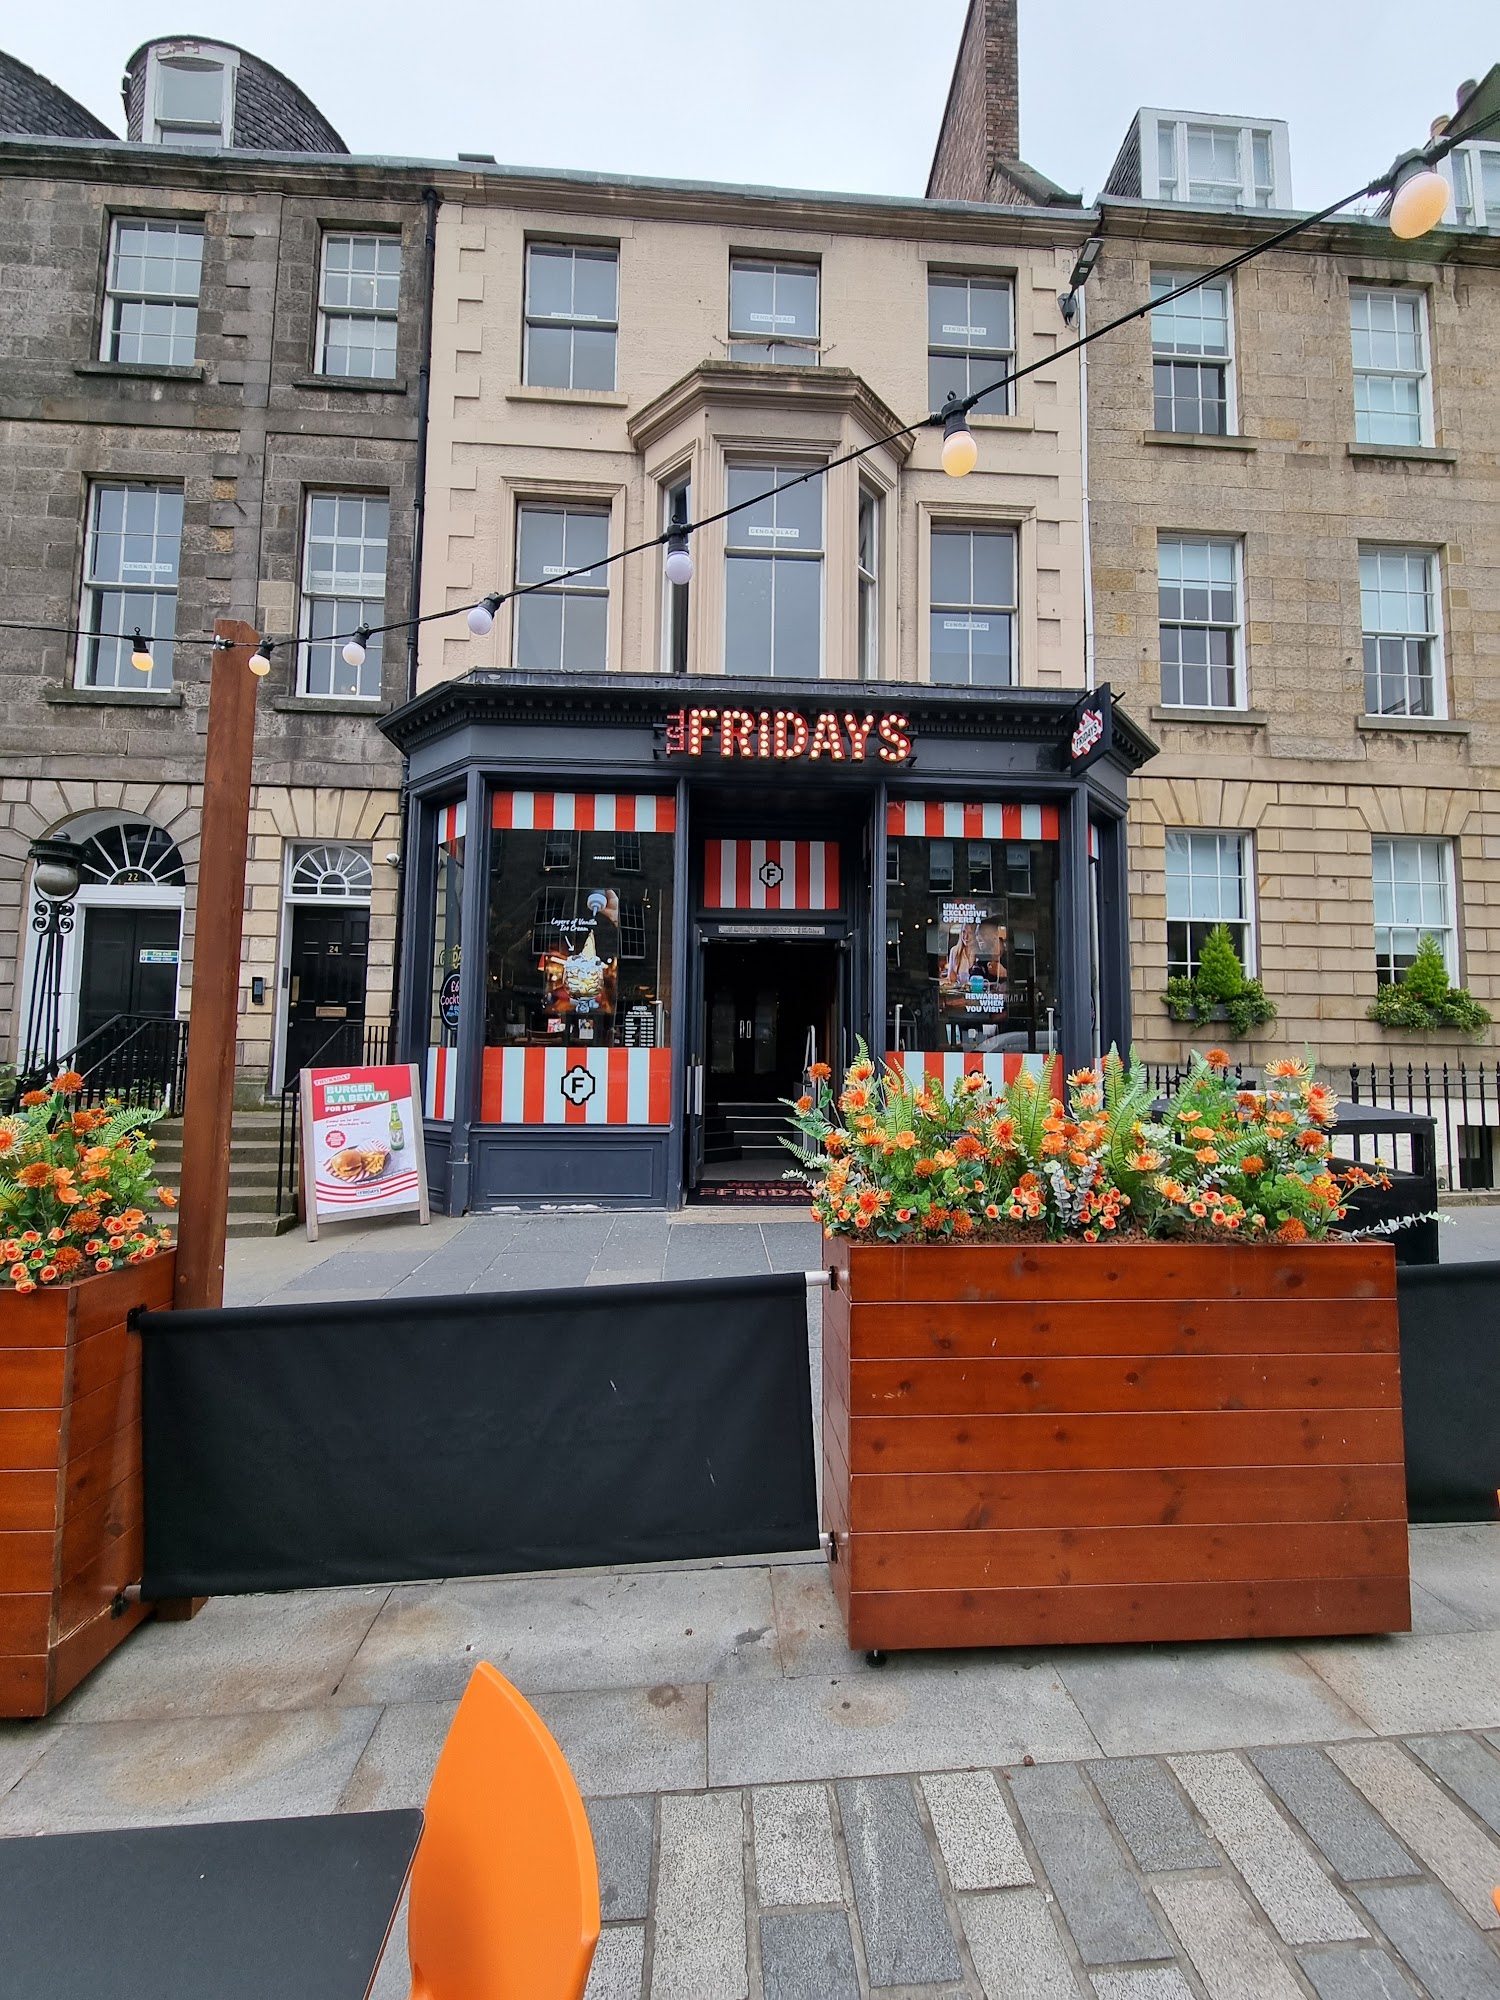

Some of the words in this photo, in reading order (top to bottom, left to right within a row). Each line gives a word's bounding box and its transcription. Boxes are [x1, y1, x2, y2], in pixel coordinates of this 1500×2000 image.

[127, 872, 139, 881] 22
[766, 868, 776, 880] F
[943, 903, 976, 911] UNLOCK
[943, 910, 987, 918] EXCLUSIVE
[551, 917, 570, 926] Layers
[329, 945, 339, 953] 24
[980, 999, 1004, 1007] WHEN
[965, 1005, 982, 1013] YOU
[315, 1074, 350, 1085] THURSDAY
[326, 1084, 373, 1095] BURGER
[571, 1077, 585, 1094] F
[326, 1095, 335, 1104] &
[337, 1095, 346, 1103] A
[348, 1091, 387, 1102] BEVVY
[325, 1105, 341, 1113] FOR
